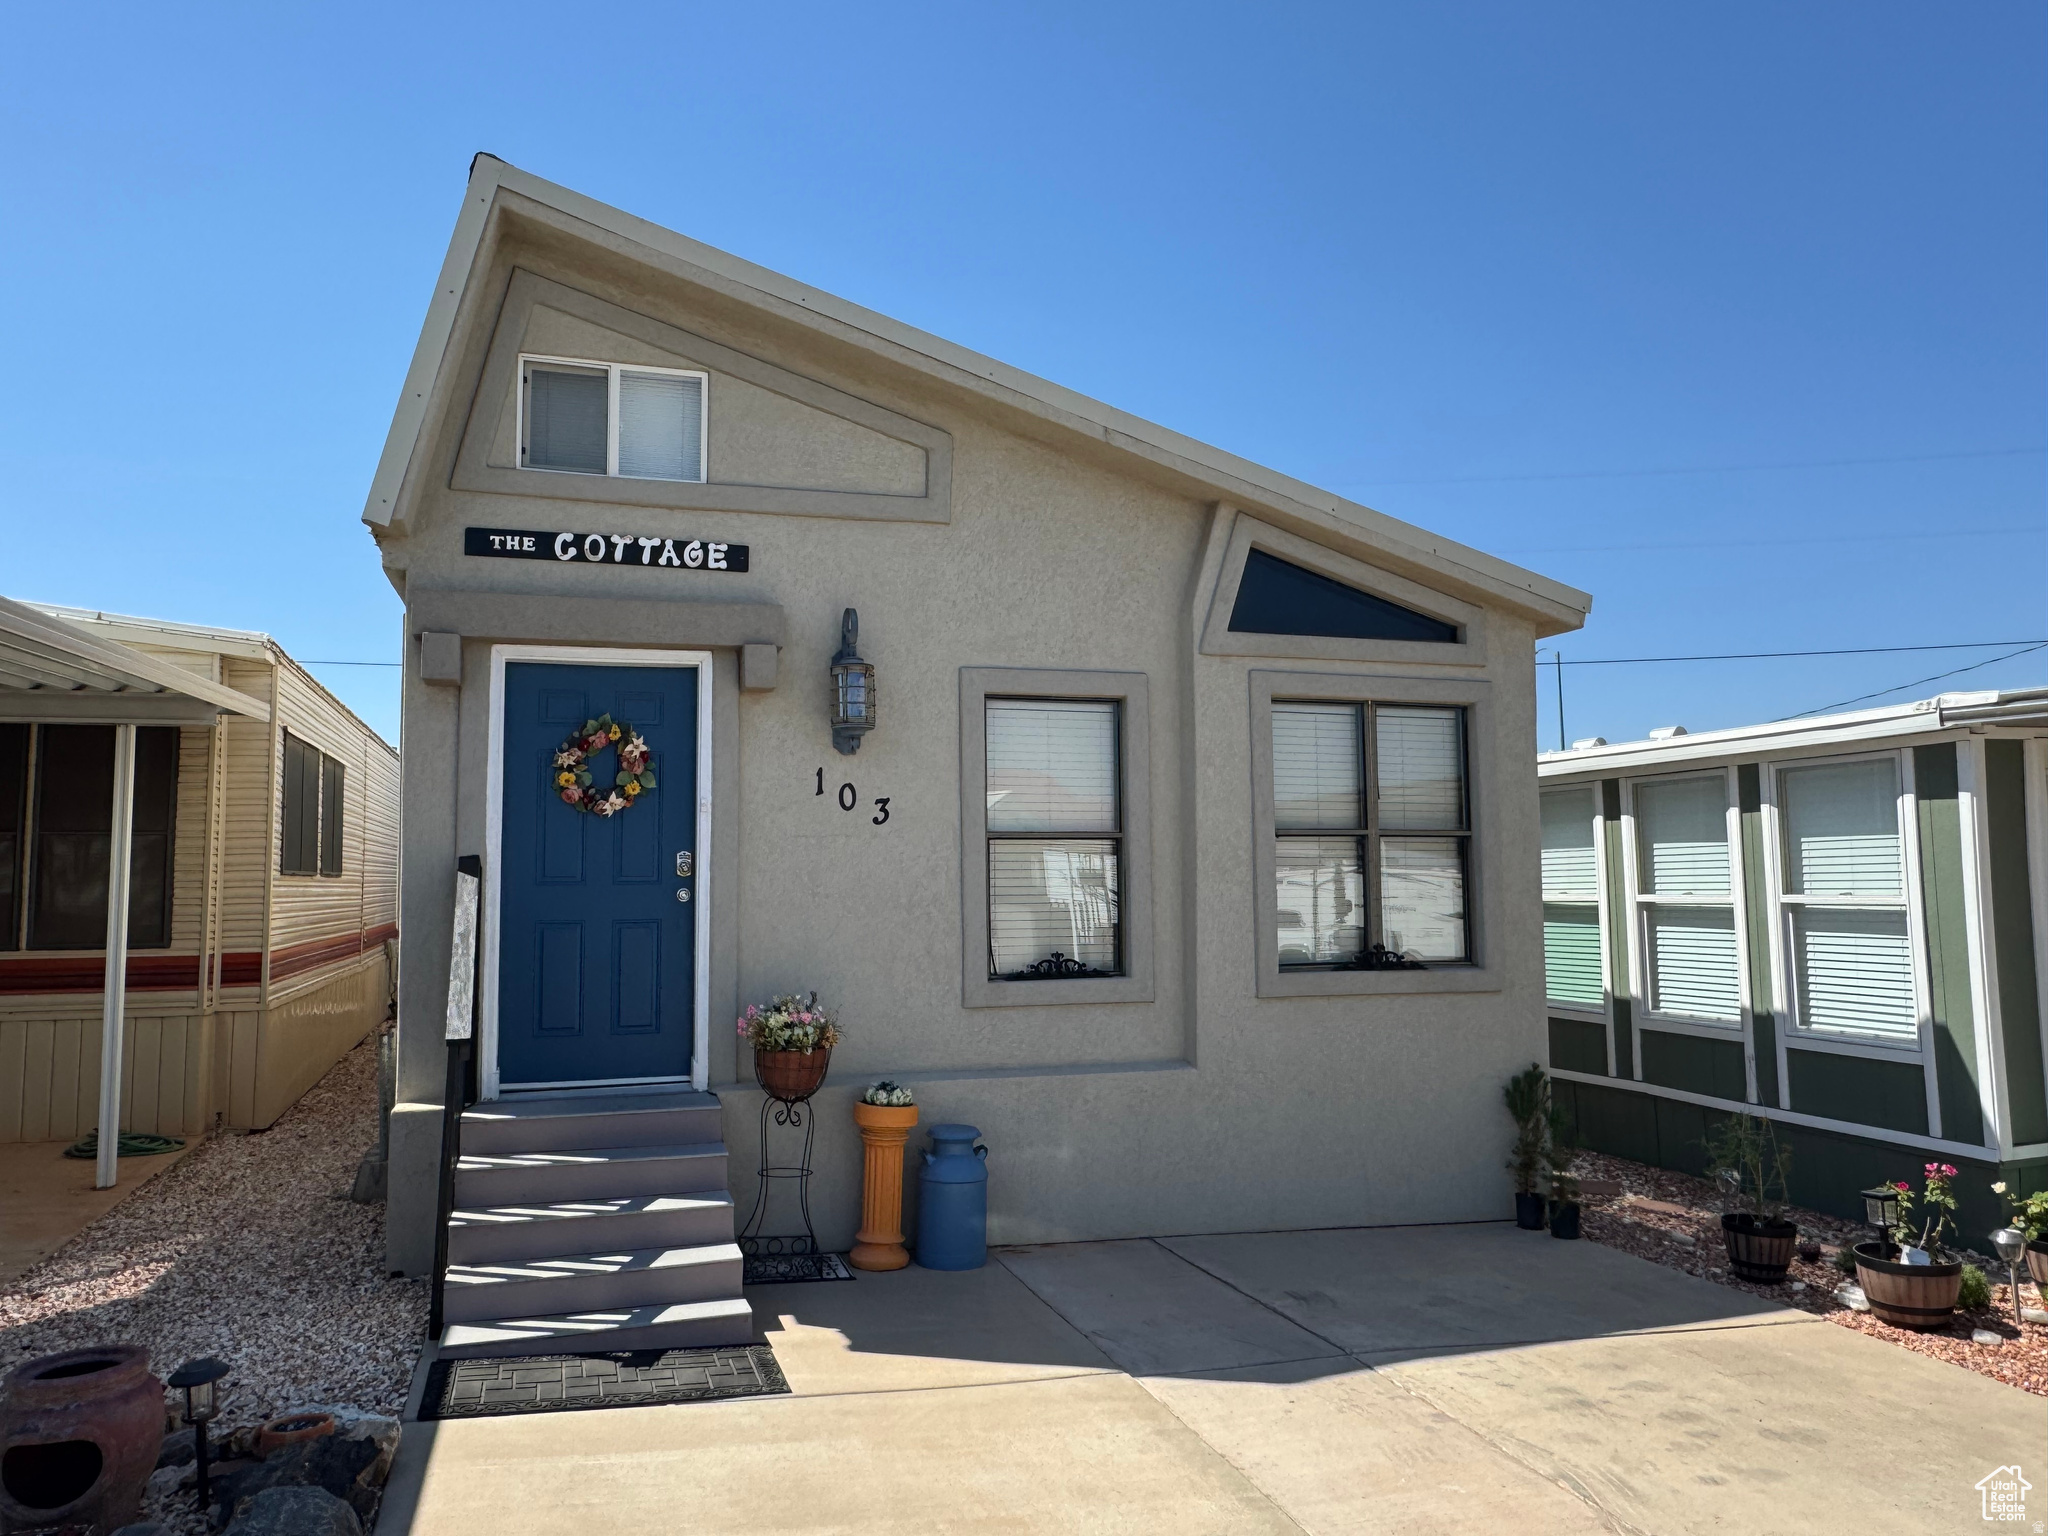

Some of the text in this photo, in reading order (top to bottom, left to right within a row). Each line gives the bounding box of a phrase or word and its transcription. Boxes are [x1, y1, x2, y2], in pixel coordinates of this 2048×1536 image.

[490, 532, 728, 569] THE COTTAGE
[815, 766, 890, 825] 103
